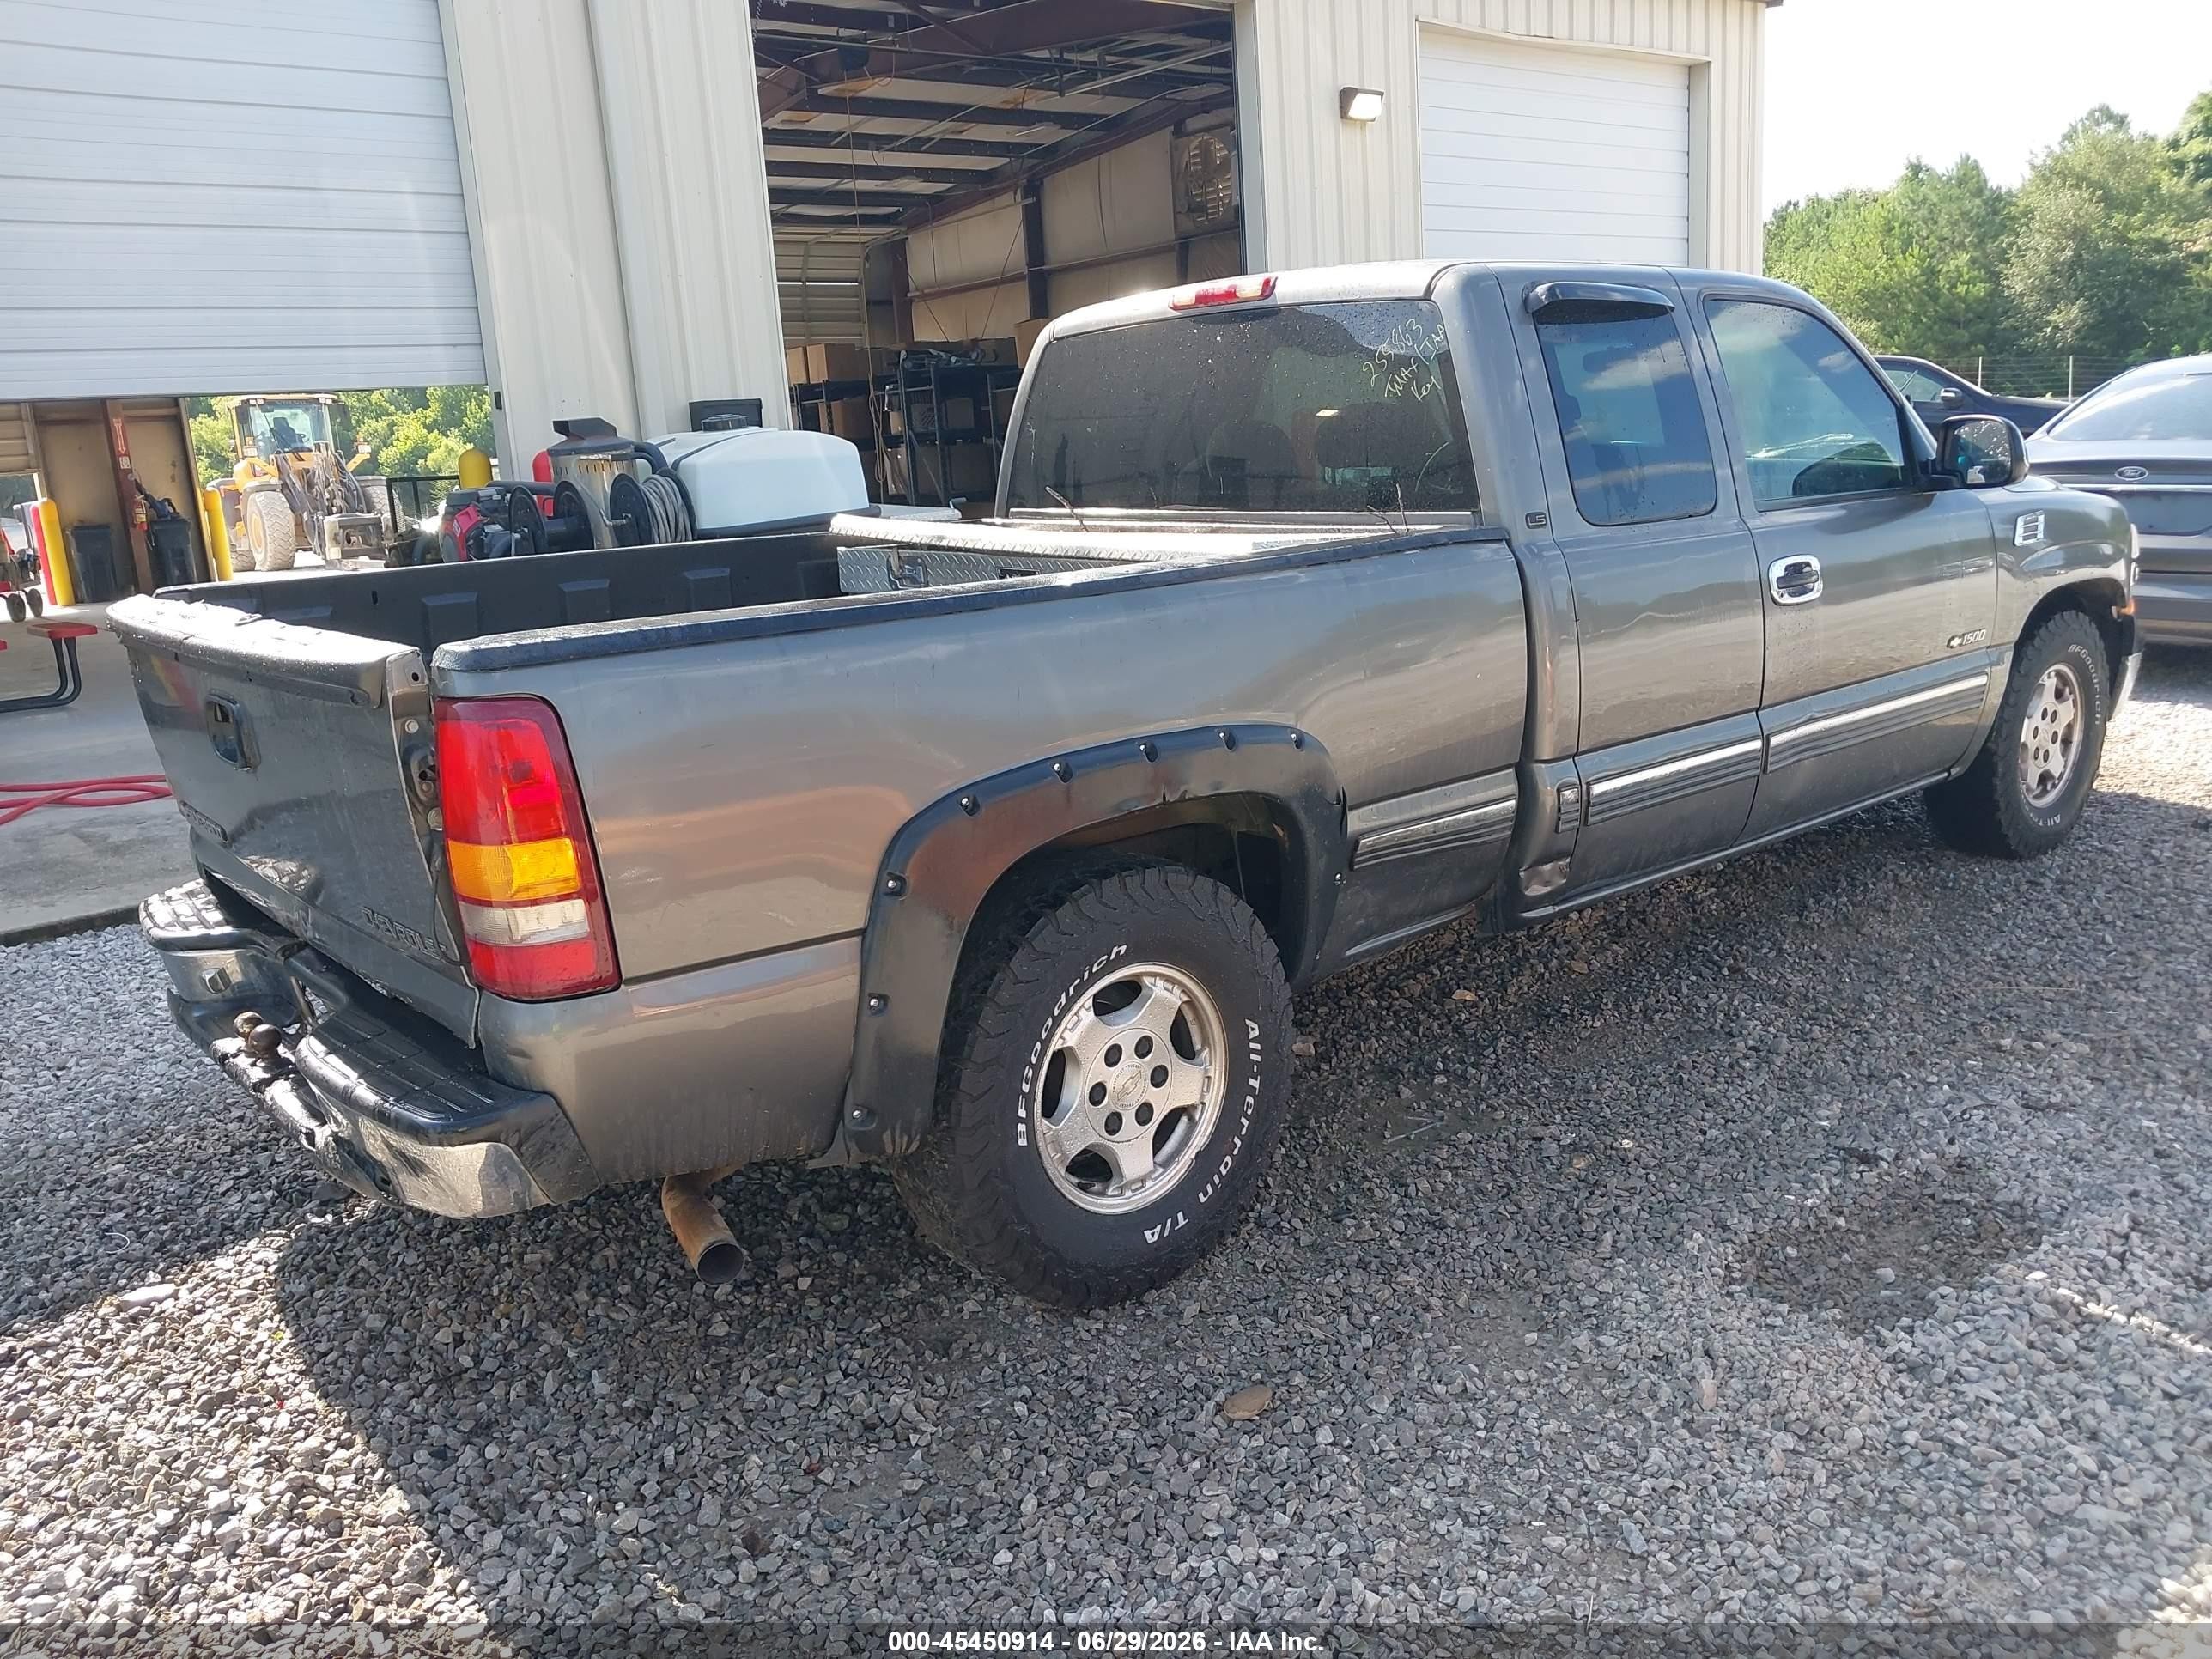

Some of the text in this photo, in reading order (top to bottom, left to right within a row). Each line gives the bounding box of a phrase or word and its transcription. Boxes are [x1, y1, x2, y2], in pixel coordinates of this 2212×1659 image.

[1528, 514, 1547, 526] LS
[1962, 629, 1987, 646] 1500
[1016, 943, 1128, 1146] BFGoodrich
[1144, 1018, 1261, 1245] All-Terrain T/A
